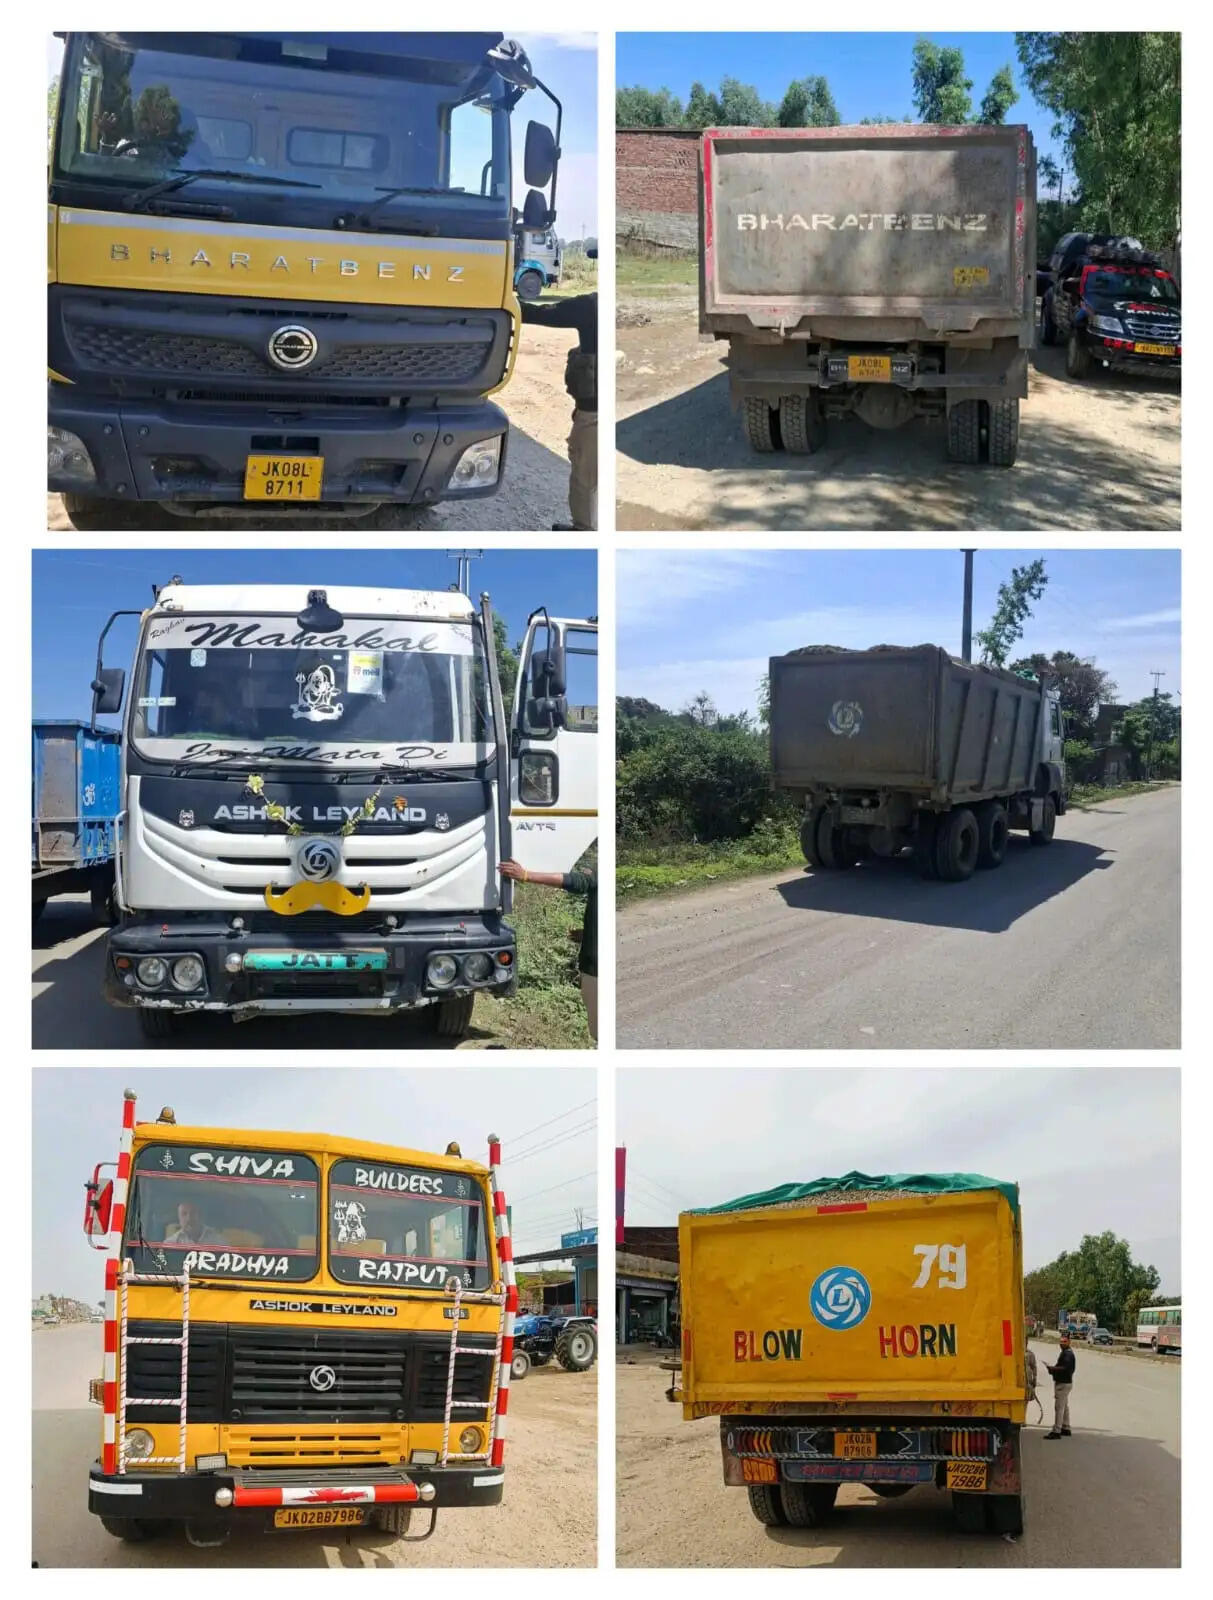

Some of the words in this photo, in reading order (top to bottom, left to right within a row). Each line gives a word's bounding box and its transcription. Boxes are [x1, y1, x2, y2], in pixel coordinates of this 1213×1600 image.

[110, 243, 465, 283] BHARATBENZ
[261, 461, 310, 478] JK08L
[265, 480, 304, 495] 8711
[185, 622, 440, 650] Mahakal
[260, 746, 384, 764] Mata
[398, 746, 448, 760] Di
[516, 822, 556, 831] AVTR
[281, 953, 359, 969] JATT
[189, 1152, 294, 1178] SHIVA
[355, 1168, 443, 1195] BUILDERS
[182, 1251, 289, 1276] ARADHYA
[358, 1259, 449, 1284] RAJPUT
[912, 1243, 967, 1290] 79
[251, 1299, 313, 1313] ASHOK
[322, 1303, 397, 1317] LEYLAND
[733, 1329, 803, 1363] BLOW
[879, 1324, 958, 1358] HORN
[284, 1509, 363, 1525] JK02BB7986
